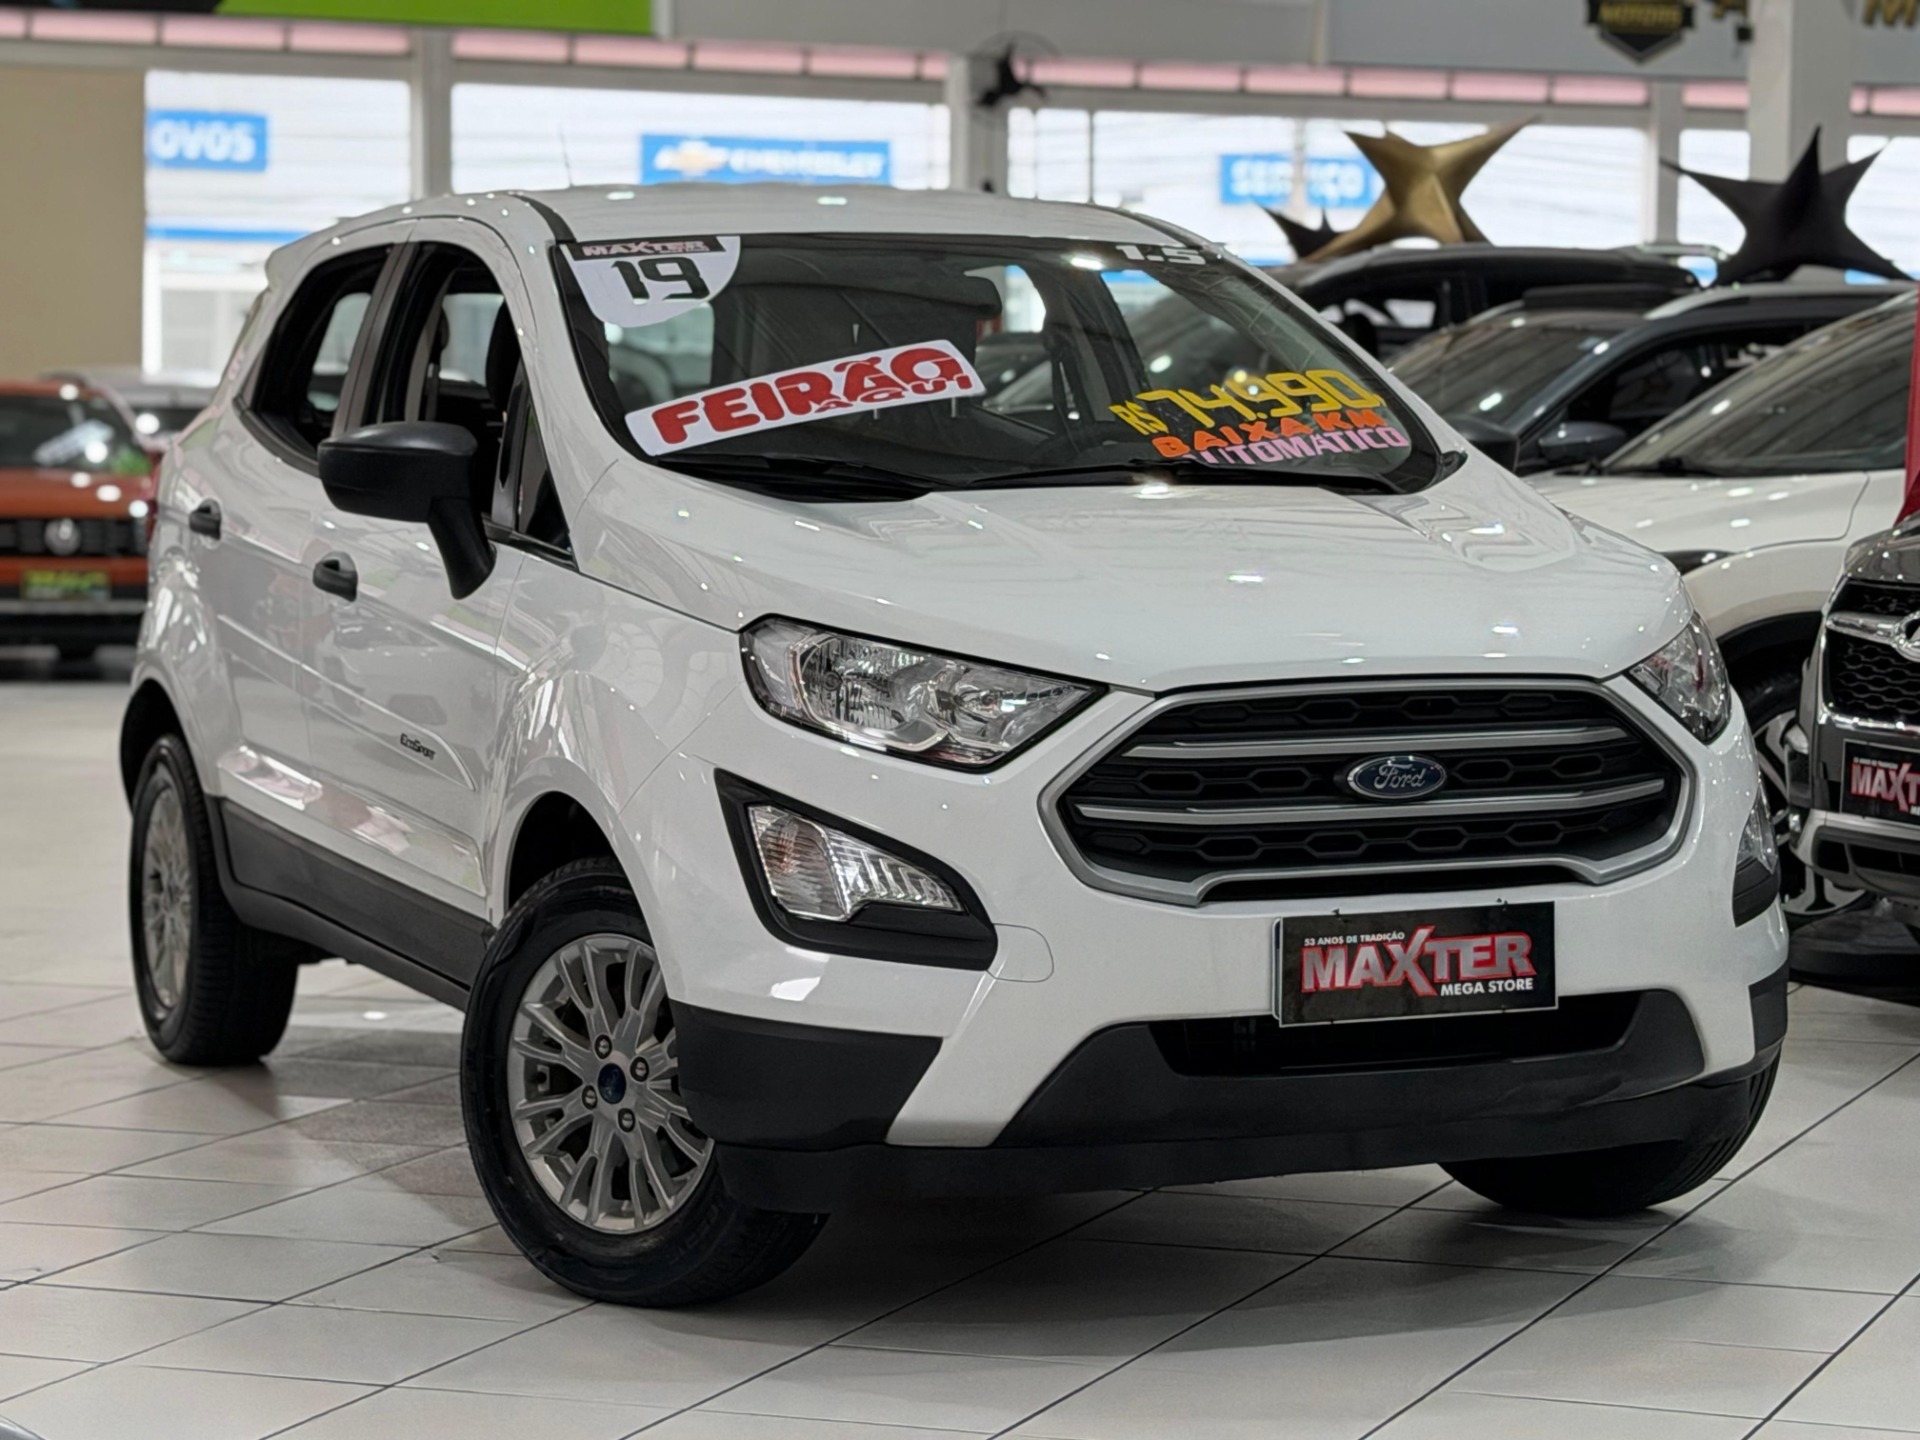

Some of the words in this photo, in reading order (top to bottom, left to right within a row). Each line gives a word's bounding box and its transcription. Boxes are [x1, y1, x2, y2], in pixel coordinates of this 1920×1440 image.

[1115, 244, 1206, 265] 1.5
[611, 256, 711, 300] 19
[651, 347, 965, 444] FEIRÃO
[814, 374, 973, 413] AQUI
[1151, 416, 1314, 459] BAIXA
[1312, 408, 1389, 431] KM
[1182, 427, 1411, 466] UTOMÁTICO
[1373, 762, 1427, 790] Ford
[1303, 938, 1316, 947] 53
[1317, 936, 1345, 946] ANOS
[1346, 935, 1359, 944] DE
[1360, 930, 1406, 943] TRADIÇÃO
[1301, 924, 1538, 995] MAXTER
[1440, 982, 1486, 997] MEGA
[1488, 977, 1534, 994] STORE
